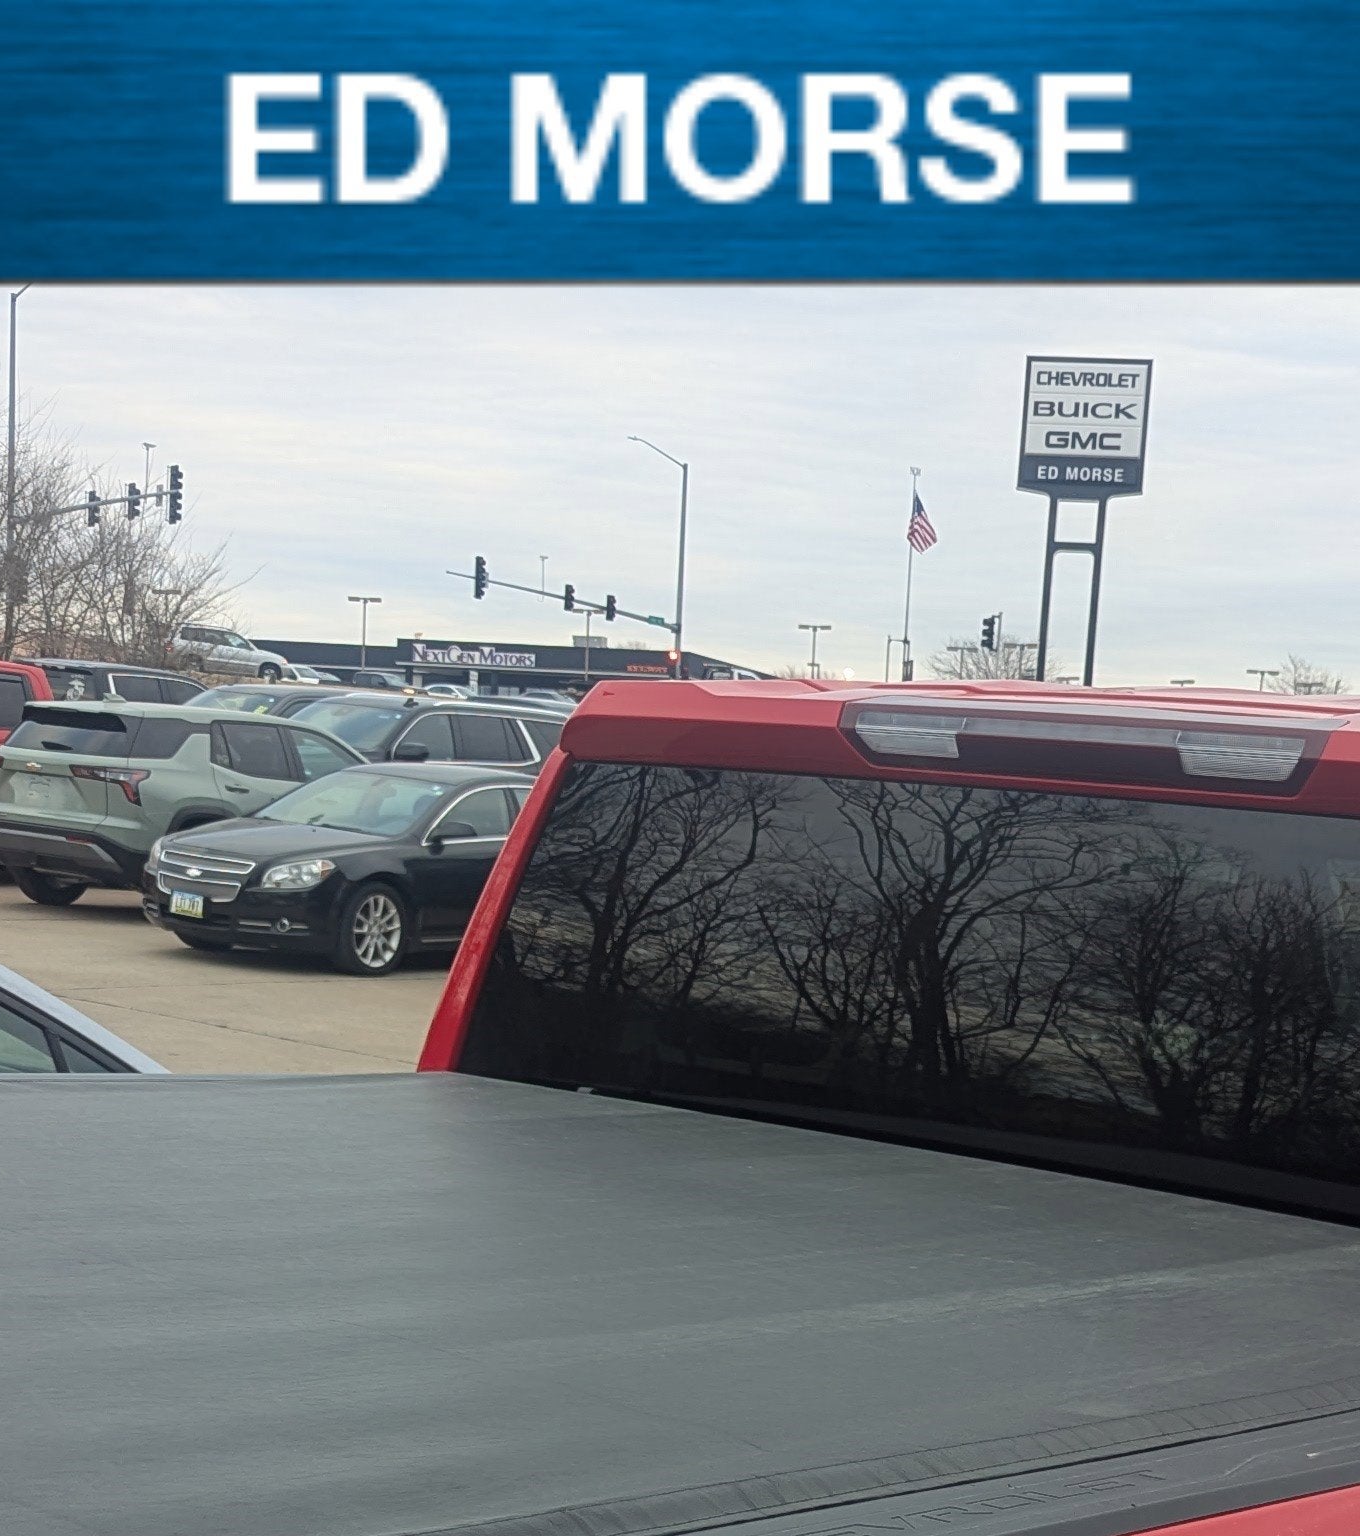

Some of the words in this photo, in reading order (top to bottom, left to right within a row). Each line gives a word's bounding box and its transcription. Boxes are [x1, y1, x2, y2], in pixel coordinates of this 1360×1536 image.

[1036, 370, 1140, 388] CHEVROLET
[1032, 400, 1138, 420] BUICK
[1044, 430, 1122, 451] GMC
[1036, 465, 1059, 480] ED
[1065, 466, 1125, 483] MORSE
